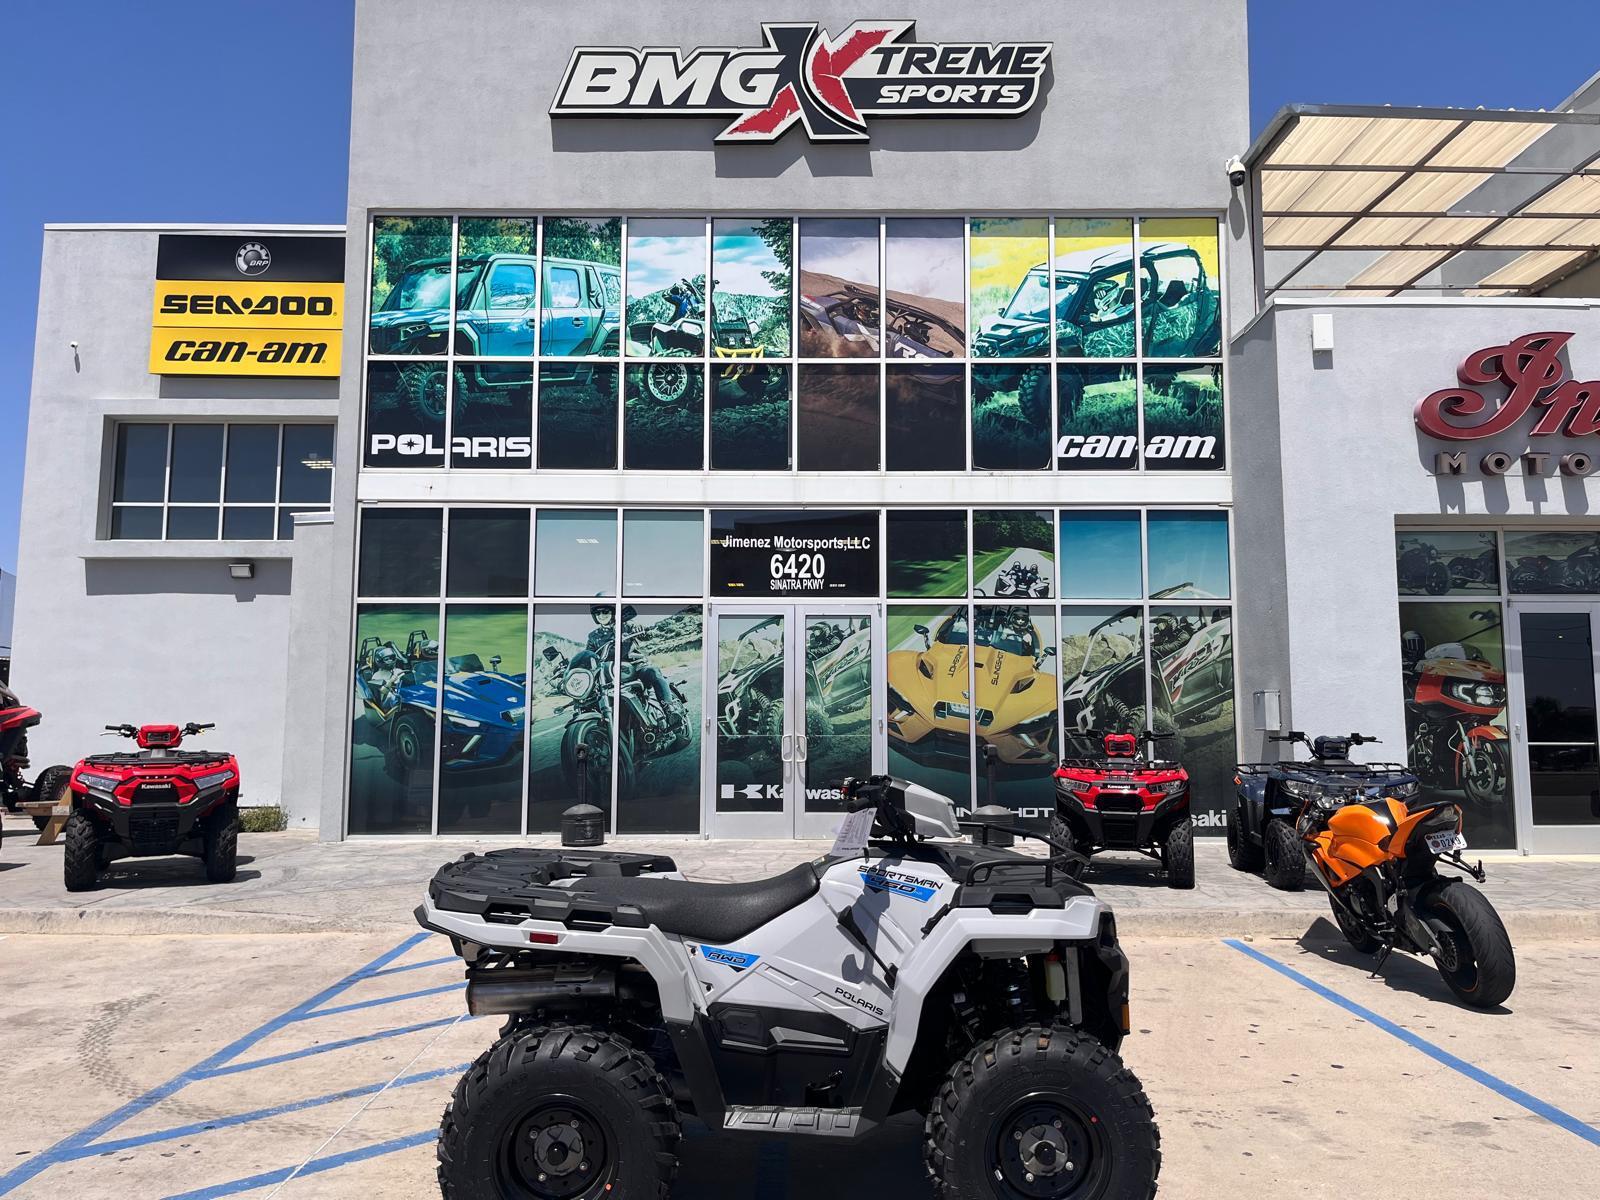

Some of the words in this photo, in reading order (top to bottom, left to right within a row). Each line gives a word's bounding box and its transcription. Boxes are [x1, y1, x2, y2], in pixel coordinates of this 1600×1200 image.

[561, 51, 787, 106] BMG
[876, 84, 1025, 104] SPORTS
[371, 434, 532, 458] POLARIS
[722, 535, 770, 548] Jimenez
[770, 553, 825, 579] 6420
[770, 579, 801, 590] SINATRA
[802, 579, 825, 590] PKWY
[857, 865, 944, 890] SPORTSMAN
[707, 952, 747, 964] AWD
[834, 987, 884, 1016] POLARIS
